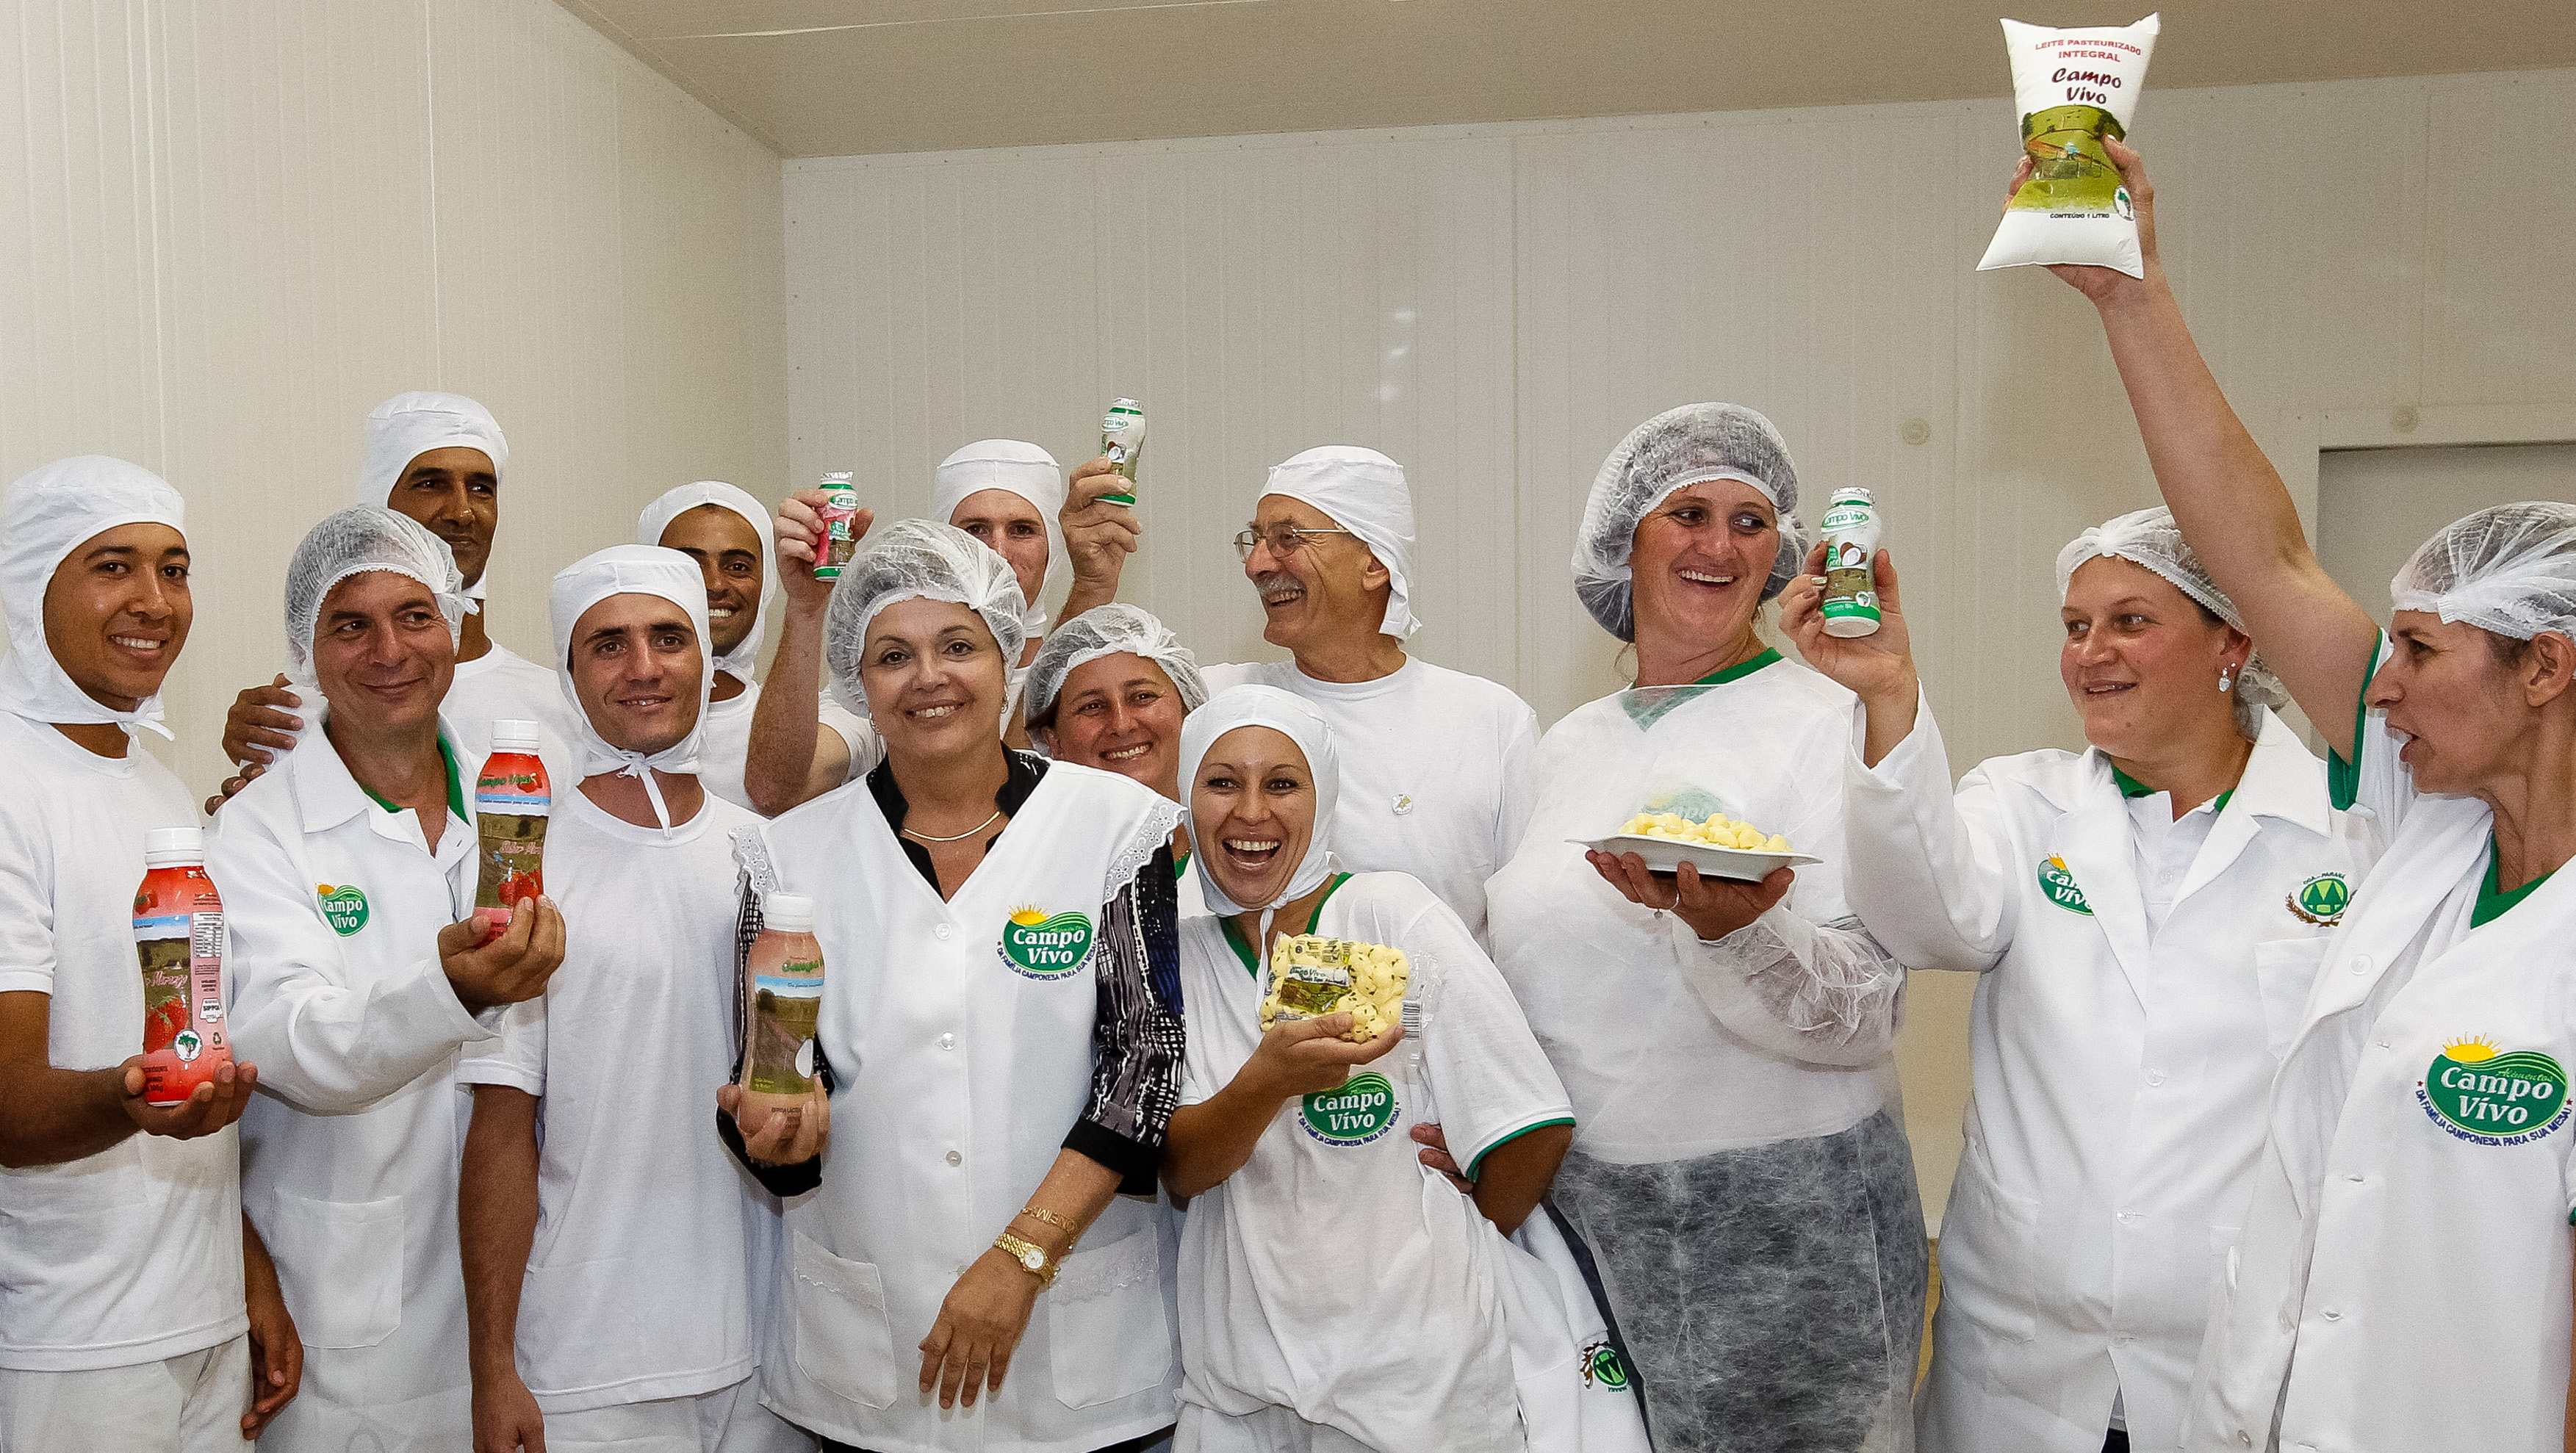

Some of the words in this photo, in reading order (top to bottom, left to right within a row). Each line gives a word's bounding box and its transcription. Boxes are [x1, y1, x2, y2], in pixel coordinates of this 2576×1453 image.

[2035, 40, 2064, 50] LEITE
[2067, 40, 2141, 55] PASTEURIZADO
[2058, 50, 2120, 62] INTEGRAL
[2051, 68, 2121, 88] Campo
[2067, 87, 2107, 104] Vivo
[1013, 929, 1086, 948] Campo
[1021, 970, 1059, 981] CAMPONESA
[1061, 970, 1076, 979] PARA
[1076, 962, 1087, 973] SUA
[2440, 1067, 2553, 1101] Campo
[2496, 1067, 2553, 1082] Alimentos
[1313, 1092, 1386, 1112] Campo
[2415, 1089, 2425, 1101] DA
[2422, 1101, 2446, 1129] FAMÍLIA
[2445, 1124, 2501, 1146] CAMPONESA
[2503, 1134, 2530, 1146] PARA
[2529, 1128, 2550, 1141] SUA
[1324, 1138, 1363, 1147] CAMPONESA
[1363, 1133, 1379, 1144] PARA
[1378, 1126, 1391, 1136] SUA
